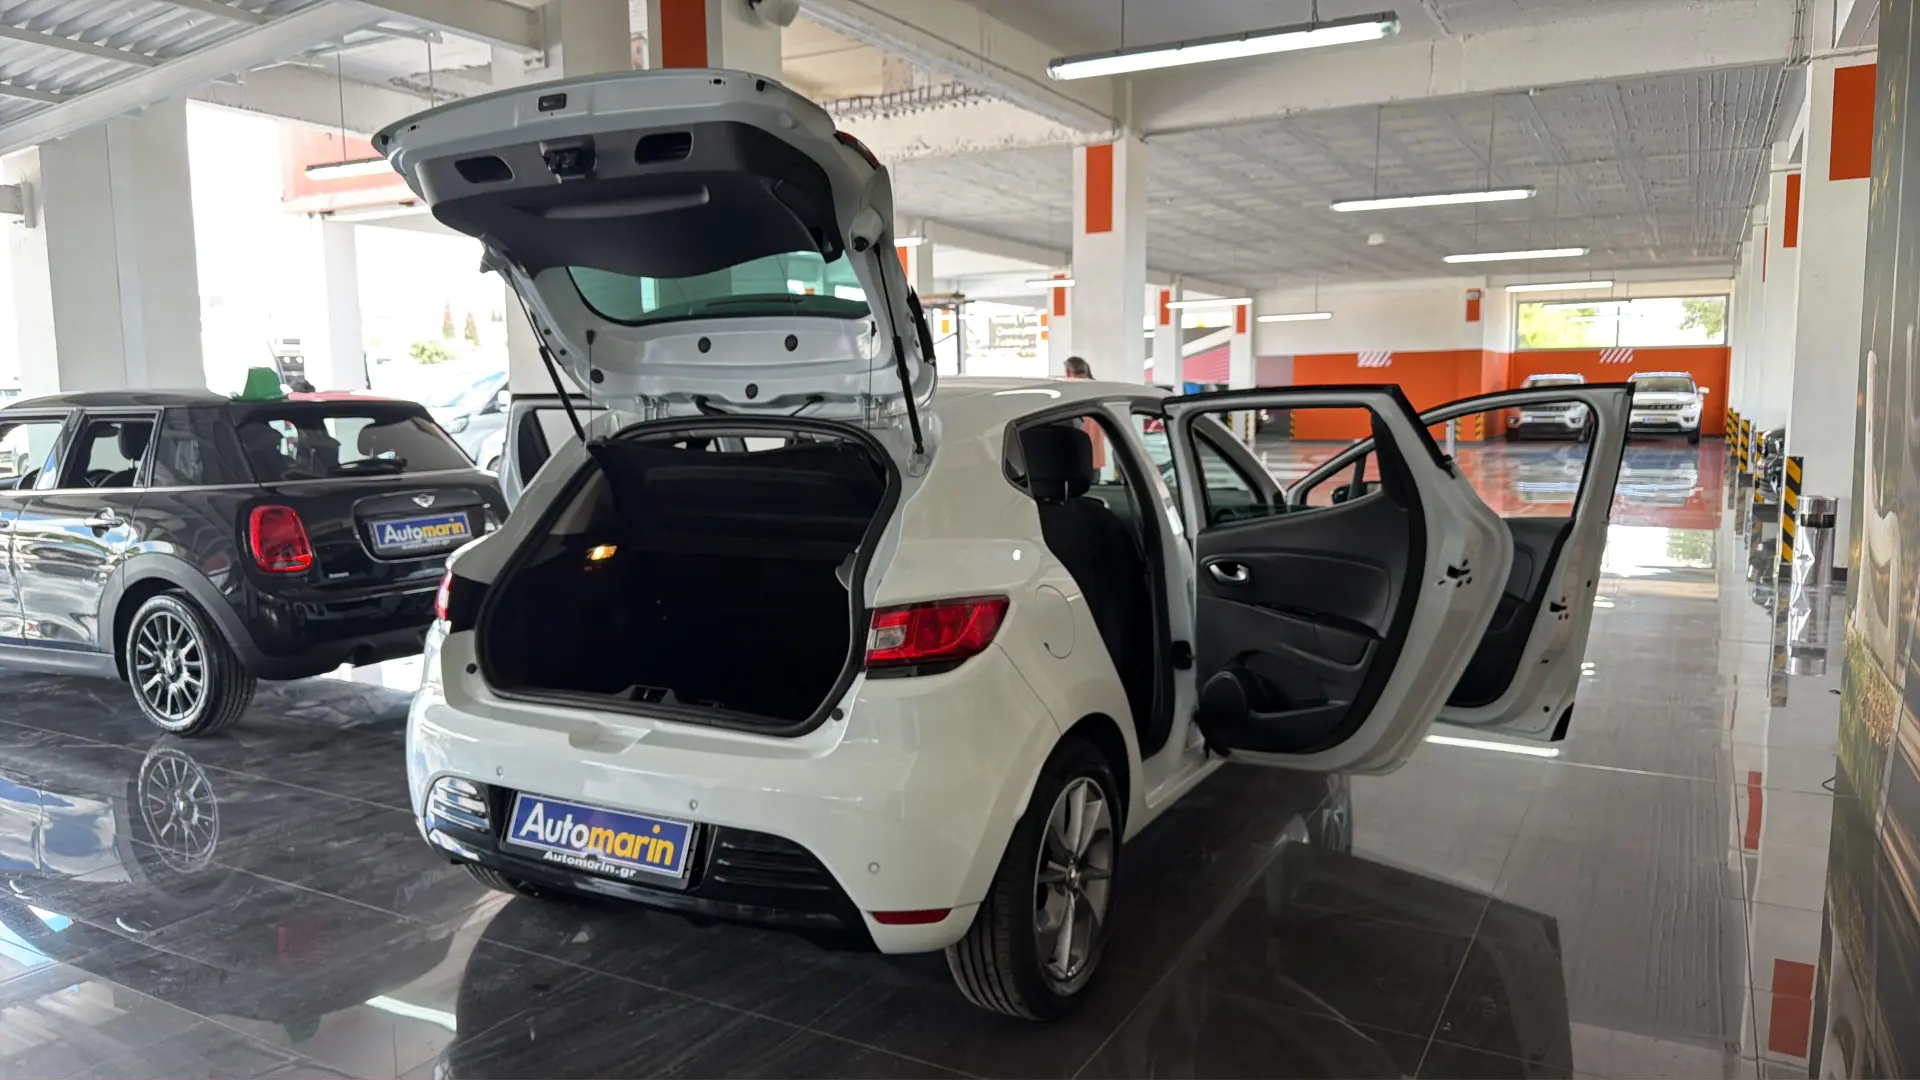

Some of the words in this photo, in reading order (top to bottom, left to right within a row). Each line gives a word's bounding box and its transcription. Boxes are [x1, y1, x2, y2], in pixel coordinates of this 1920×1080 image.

[384, 517, 465, 544] Automarin
[519, 802, 674, 866] Automarin
[543, 850, 637, 878] Automarin.gr
